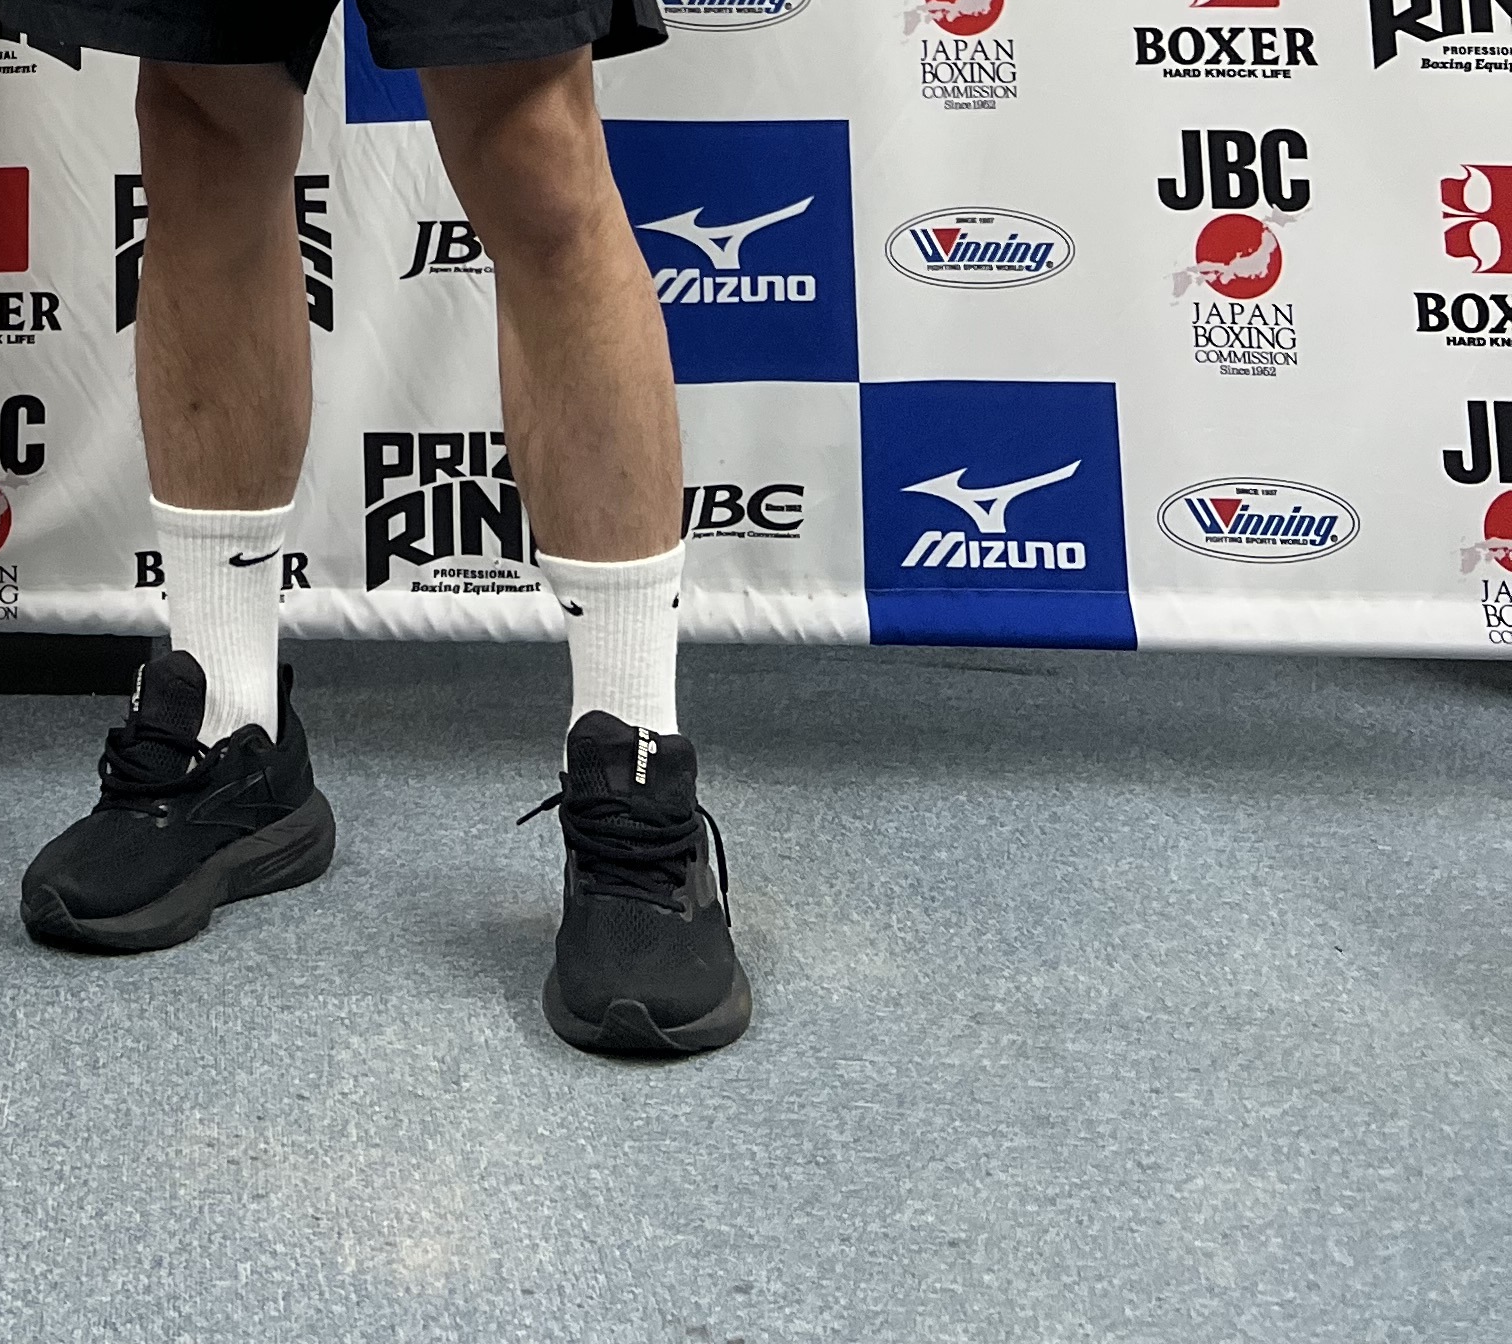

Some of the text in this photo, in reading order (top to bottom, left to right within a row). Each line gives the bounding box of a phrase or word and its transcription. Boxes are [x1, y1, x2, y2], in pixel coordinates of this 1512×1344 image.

[921, 39, 1013, 61] JAPAN
[1134, 27, 1318, 66] BOXER
[921, 62, 1016, 84] BOXING
[1163, 68, 1291, 78] HARD KNOCK LIFE
[922, 85, 1017, 99] COMMISSION
[1158, 129, 1310, 212] JBC
[910, 229, 1053, 271] Winning
[1185, 500, 1336, 545] Winning
[902, 531, 1085, 569] MIZUNO
[433, 568, 521, 580] PROFESSIONAL
[411, 581, 541, 595] Boxing Equipment
